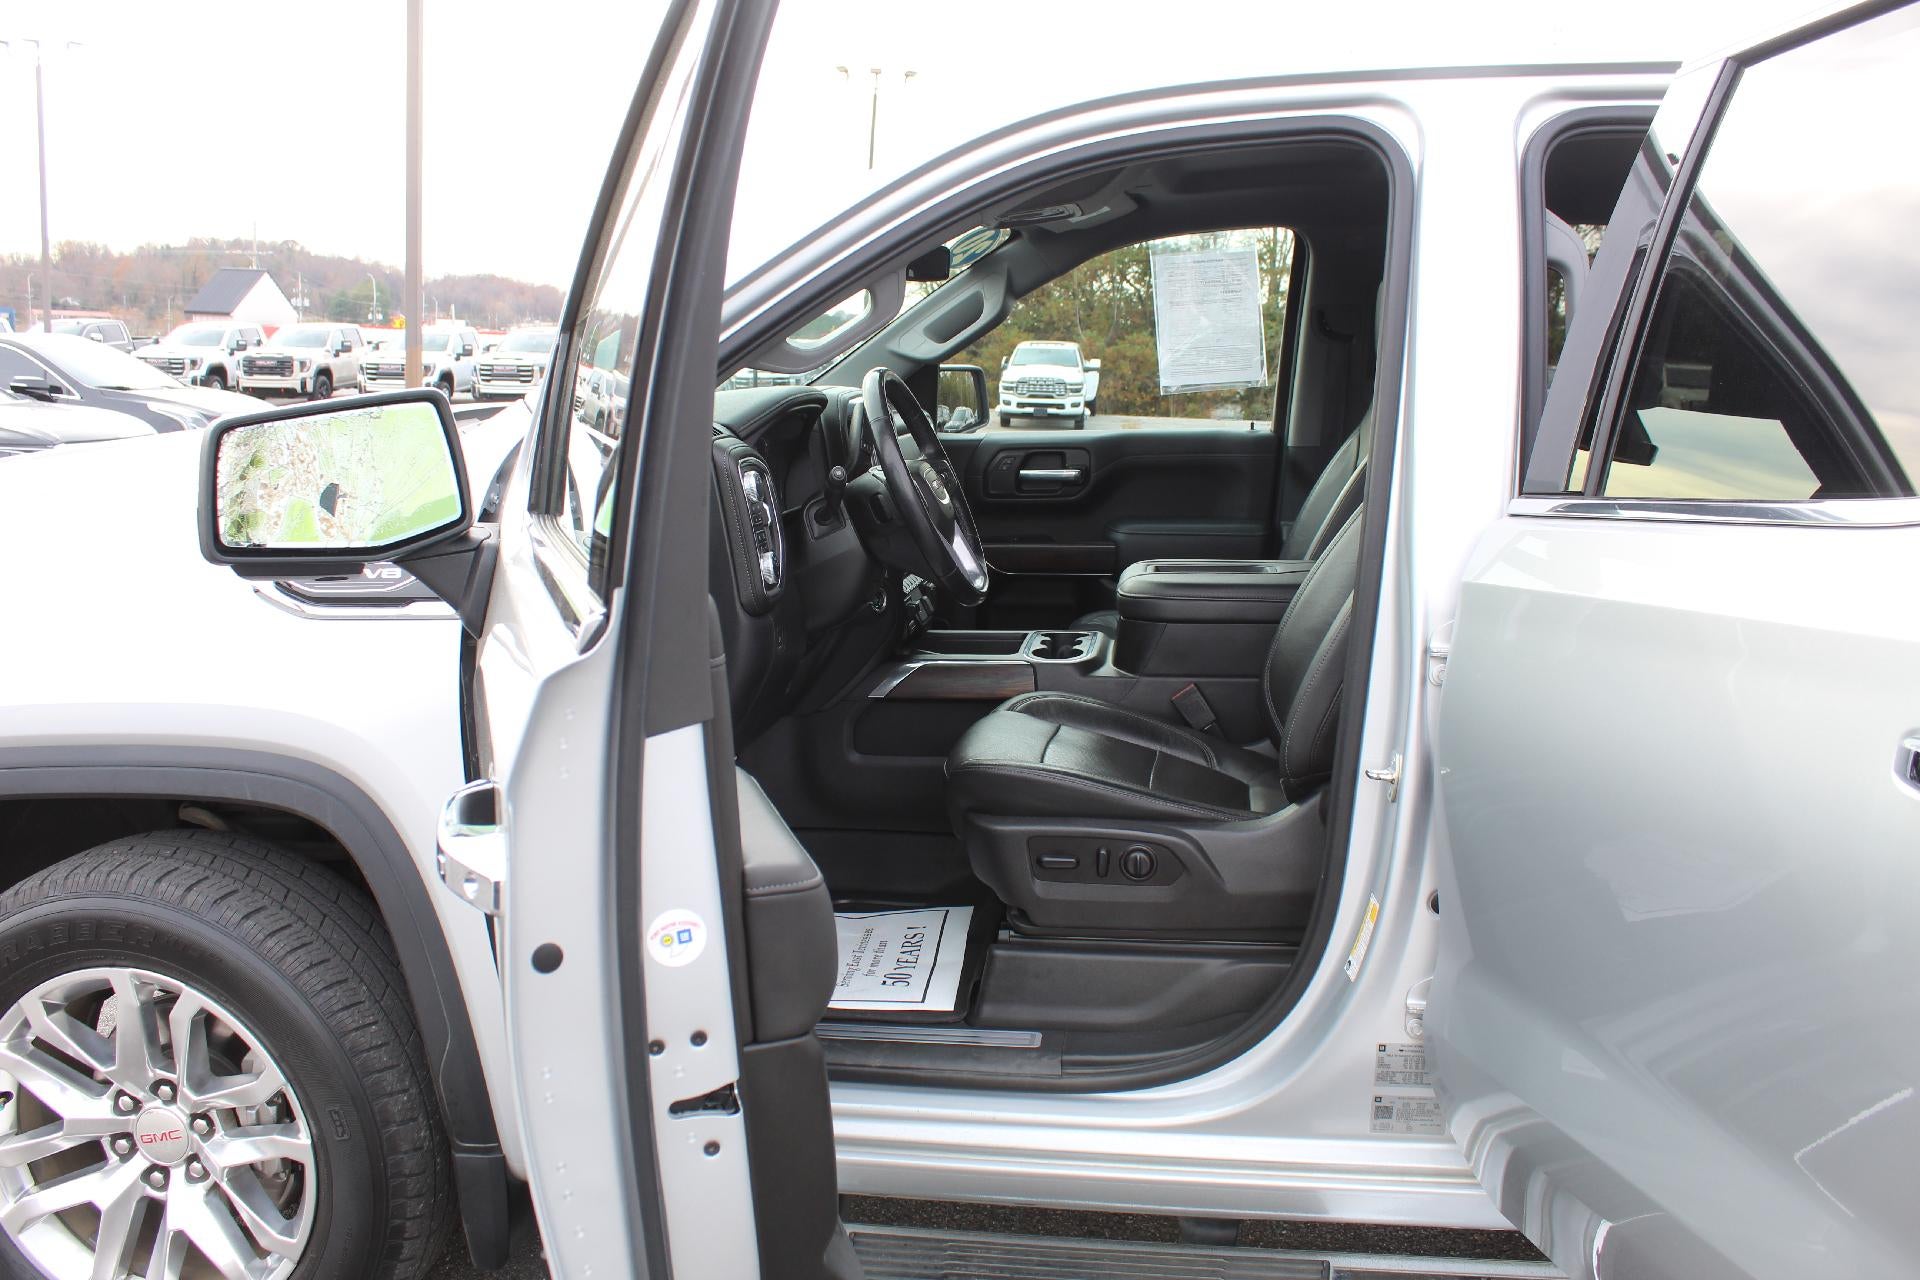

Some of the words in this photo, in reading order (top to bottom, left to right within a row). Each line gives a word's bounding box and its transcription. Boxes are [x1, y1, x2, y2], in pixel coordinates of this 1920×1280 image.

[362, 567, 402, 579] V8
[872, 940, 888, 954] than
[846, 954, 862, 967] East
[870, 954, 884, 968] more
[836, 966, 861, 988] Serving
[862, 969, 878, 977] for
[881, 973, 913, 987] 50
[140, 1129, 182, 1144] GMC
